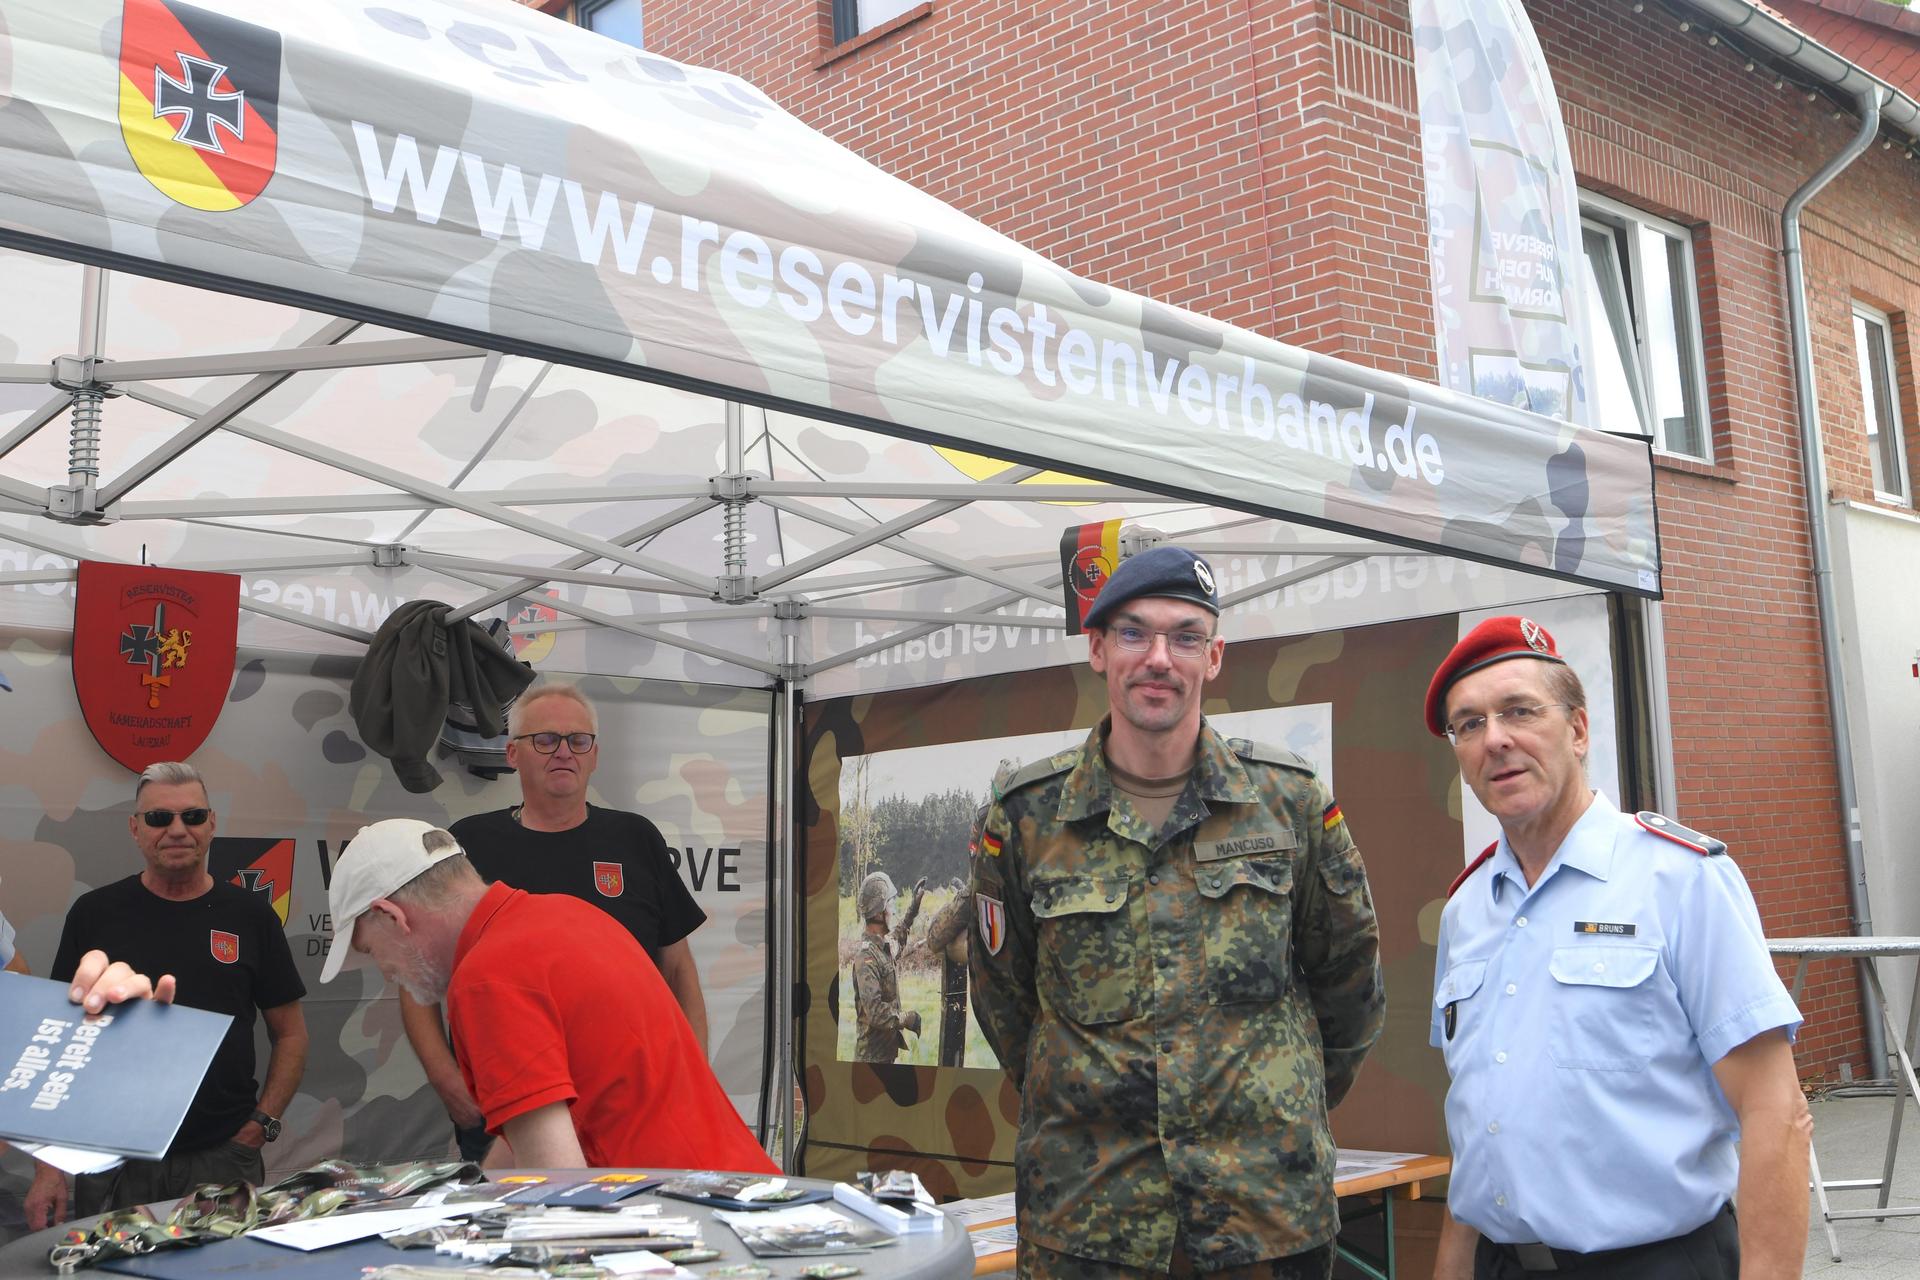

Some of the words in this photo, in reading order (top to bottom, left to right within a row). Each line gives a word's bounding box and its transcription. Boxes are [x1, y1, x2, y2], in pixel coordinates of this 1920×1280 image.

[351, 120, 1445, 486] www.reservistenverband.de
[127, 584, 194, 606] RESERVISTEN
[108, 711, 193, 729] KAMERADSCHAFT
[1216, 837, 1275, 856] MANCUSO
[1599, 924, 1624, 934] BRUNS
[32, 1018, 73, 1045] ist
[0, 1044, 51, 1092] alles.
[30, 1071, 75, 1111] sein
